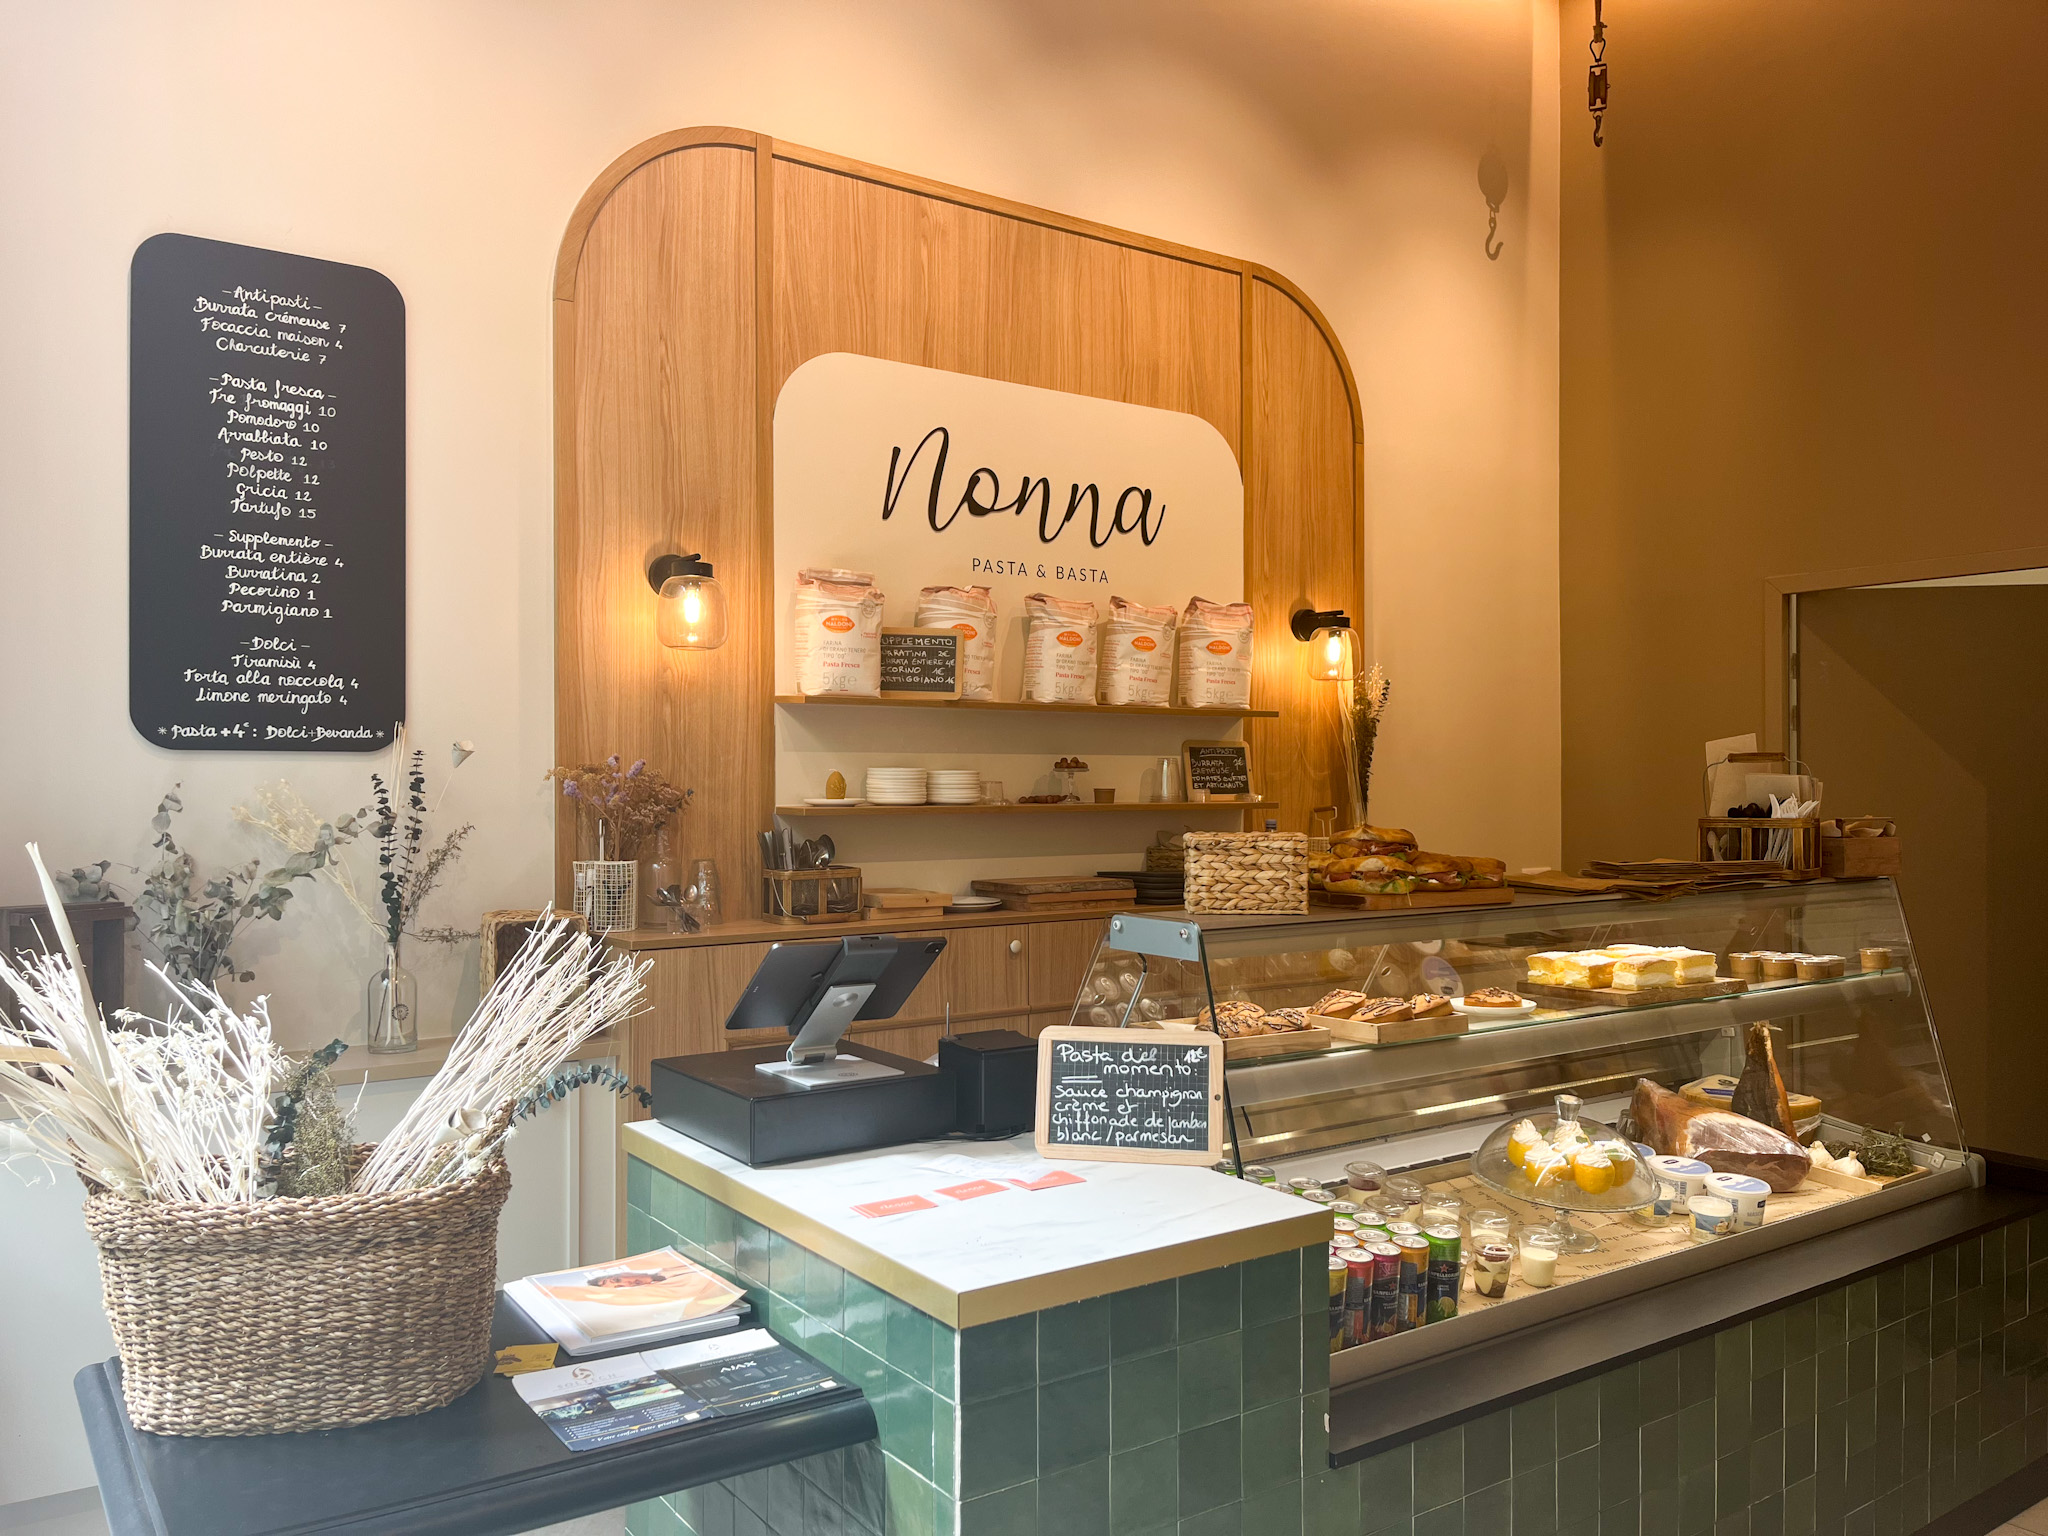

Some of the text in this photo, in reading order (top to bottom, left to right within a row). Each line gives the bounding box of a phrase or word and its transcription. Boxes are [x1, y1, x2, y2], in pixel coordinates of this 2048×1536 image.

[193, 296, 347, 334] Burrata crémeuse 7
[200, 317, 343, 350] Focaccia maison 4
[216, 337, 327, 365] Charcuterie 7
[209, 388, 336, 420] Tre fromaggi 10
[227, 409, 320, 433] Pomodoro 10
[217, 427, 328, 451] Arrabbiata 10
[240, 447, 307, 467] Pesto 12
[227, 462, 320, 485] Polpette 12
[295, 491, 312, 502] 12
[882, 426, 1166, 548] Nonna
[230, 498, 317, 520] Tartufo 15
[200, 545, 344, 568] Burrata entière 4
[225, 565, 321, 584] Burratina 2
[972, 558, 1109, 584] PASTA & BASTA
[229, 582, 316, 600] Pecorino 1
[221, 600, 333, 624] Parmigiano 1
[231, 654, 316, 670] Tiramisù 4
[881, 658, 908, 666] URRATA
[881, 666, 921, 674] ECORINO
[184, 668, 359, 690] Torta alla nocciola 4
[881, 675, 944, 684] ARMIGGIANO
[195, 687, 348, 714] Limone meringato 4
[171, 724, 217, 740] Pasta
[1056, 1043, 1114, 1064] Pasta
[1116, 1083, 1202, 1107] champignon
[1054, 1099, 1139, 1114] crème et
[1052, 1109, 1207, 1135] chiffonade de jambon
[720, 1360, 758, 1373] AJAX
